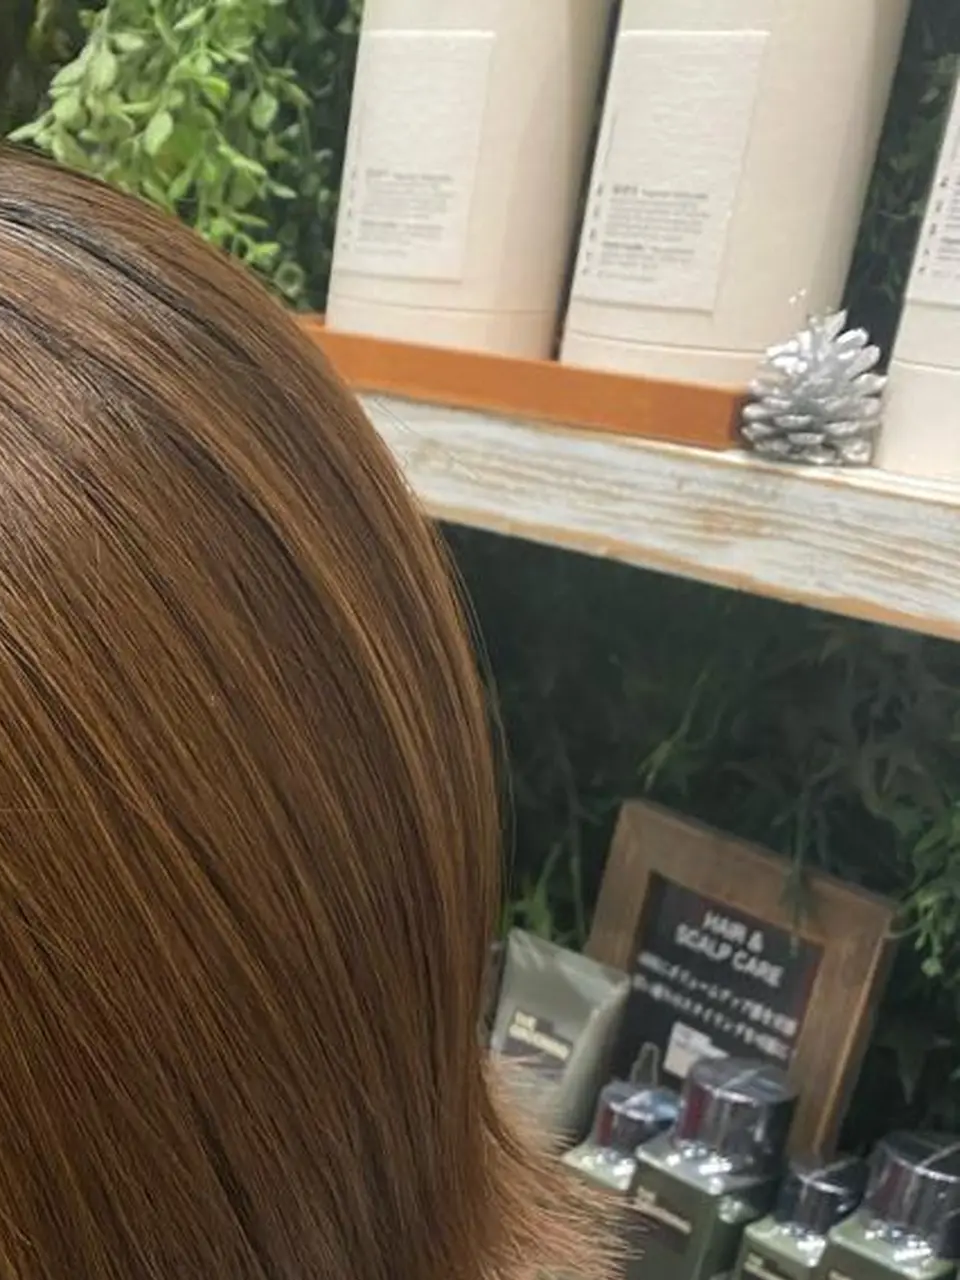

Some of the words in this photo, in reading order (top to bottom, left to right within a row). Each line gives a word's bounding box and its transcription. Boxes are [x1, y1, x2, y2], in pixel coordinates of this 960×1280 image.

[703, 910, 748, 945] HAIR
[675, 922, 733, 962] SCALP
[731, 949, 785, 988] CARE
